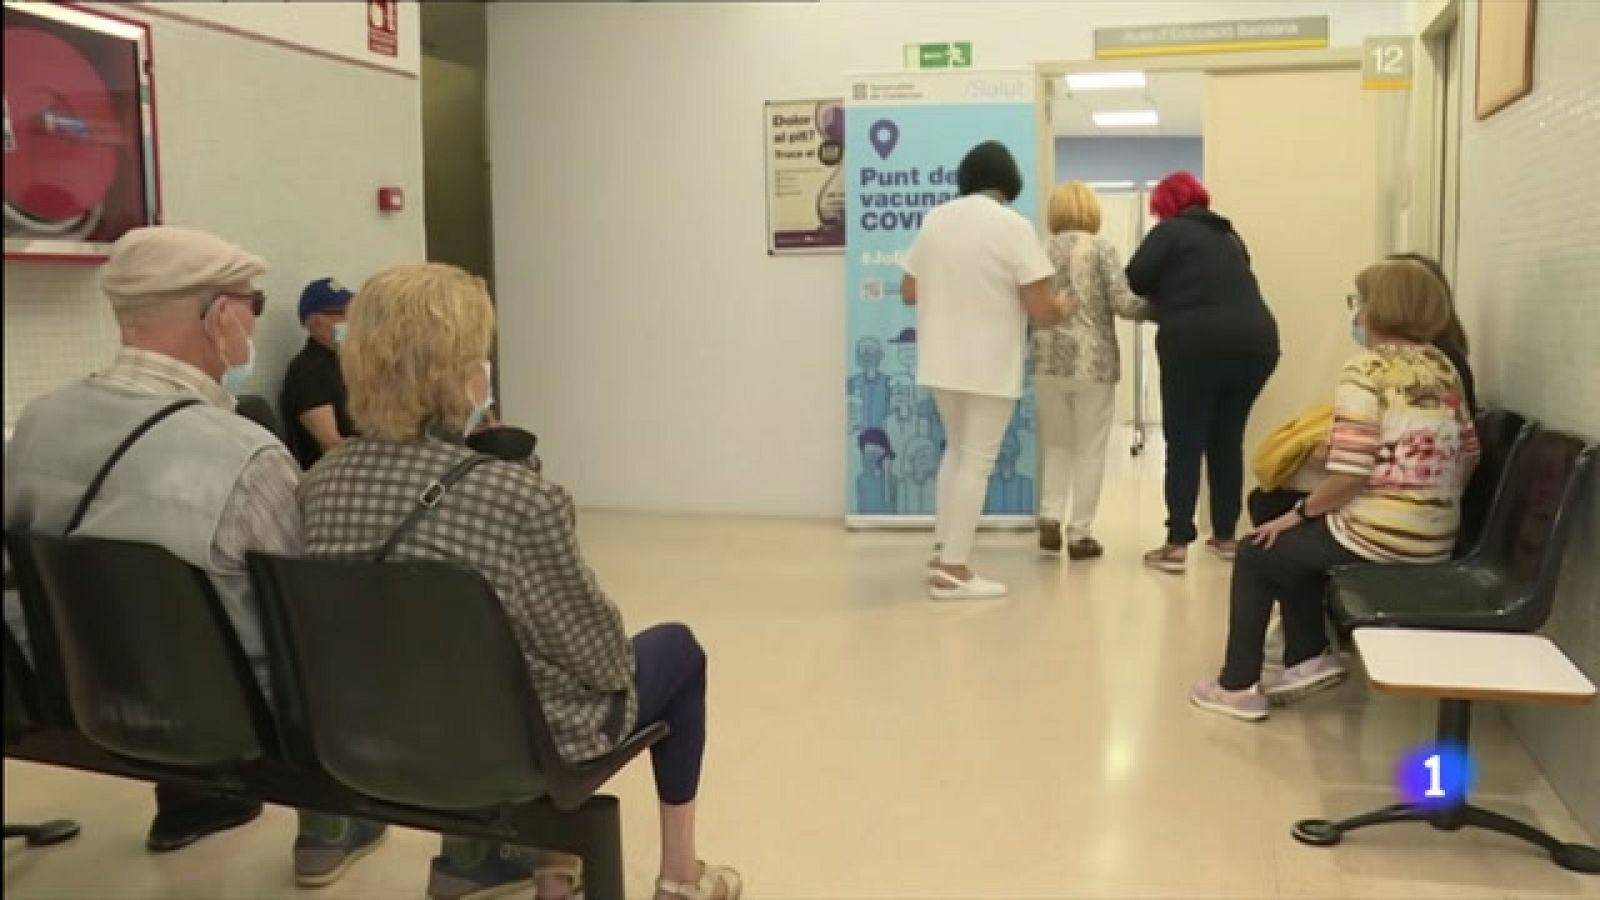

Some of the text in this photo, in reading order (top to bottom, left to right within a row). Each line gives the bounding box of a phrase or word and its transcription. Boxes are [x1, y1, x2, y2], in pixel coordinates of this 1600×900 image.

[1371, 45, 1403, 73] 12
[860, 167, 920, 187] Punt
[860, 191, 957, 208] vacuna
[861, 211, 924, 231] COVI
